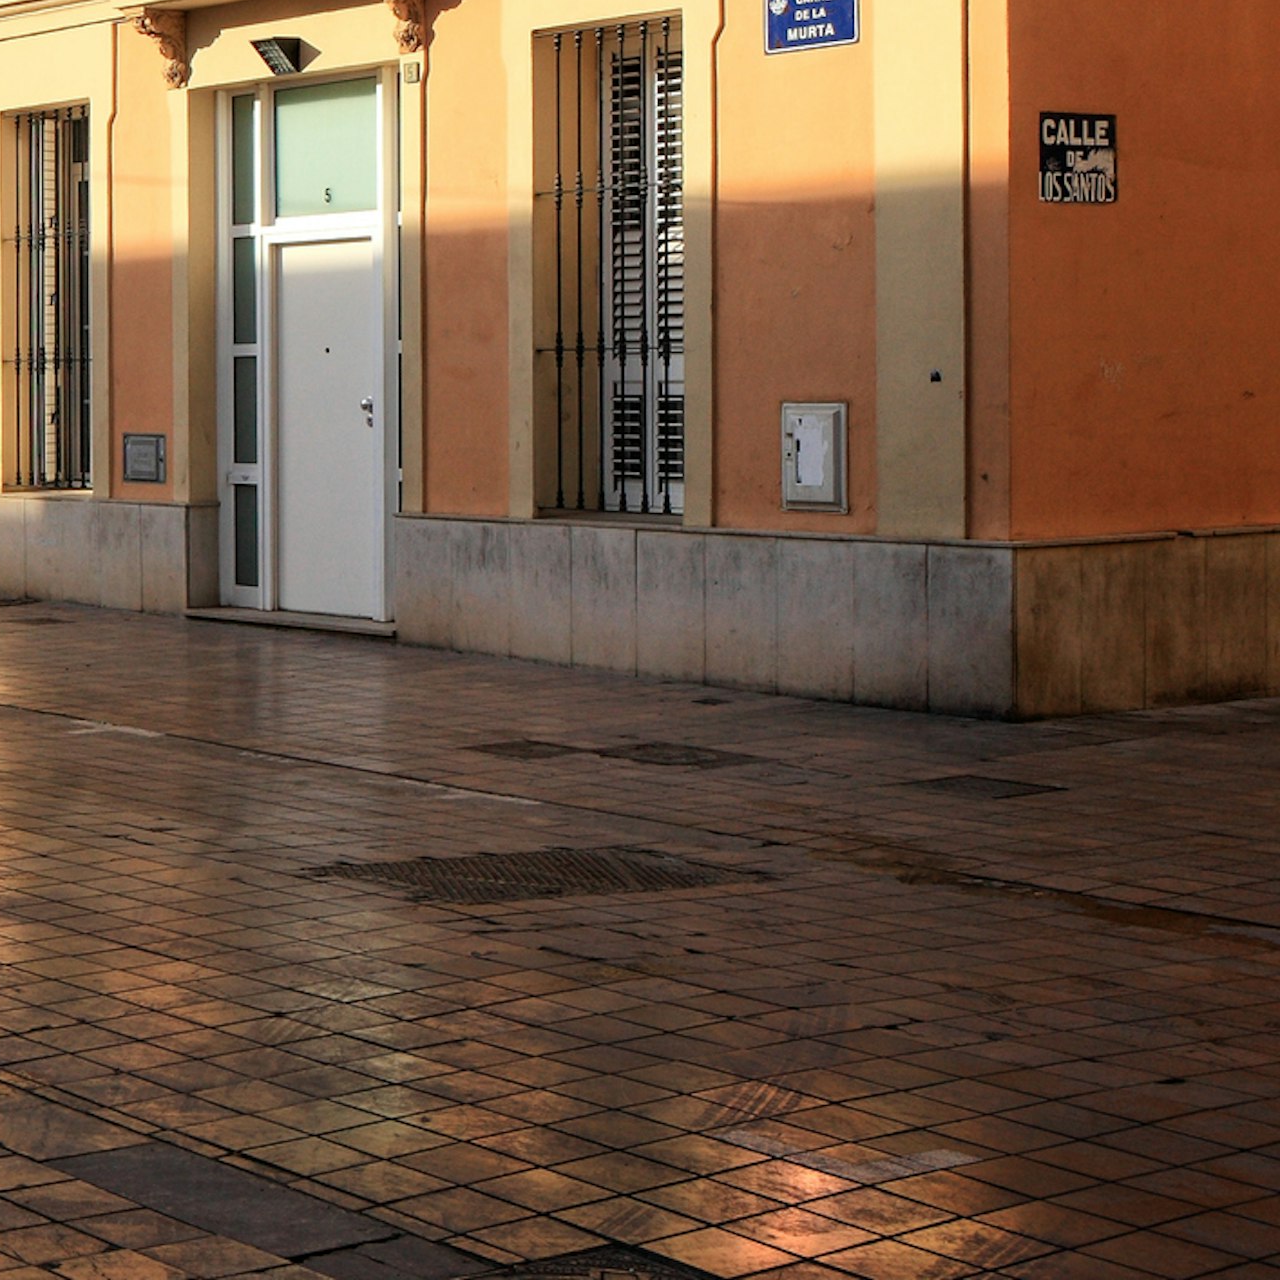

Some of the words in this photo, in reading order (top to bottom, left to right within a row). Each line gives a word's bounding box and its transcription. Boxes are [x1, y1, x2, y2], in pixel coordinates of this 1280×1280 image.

[795, 9, 811, 21] DE
[812, 7, 827, 19] LA
[786, 23, 835, 41] MURTA
[1042, 118, 1109, 146] CALLE
[324, 186, 333, 204] 5
[1038, 170, 1062, 202] LOS
[1063, 171, 1115, 202] SANTOS
